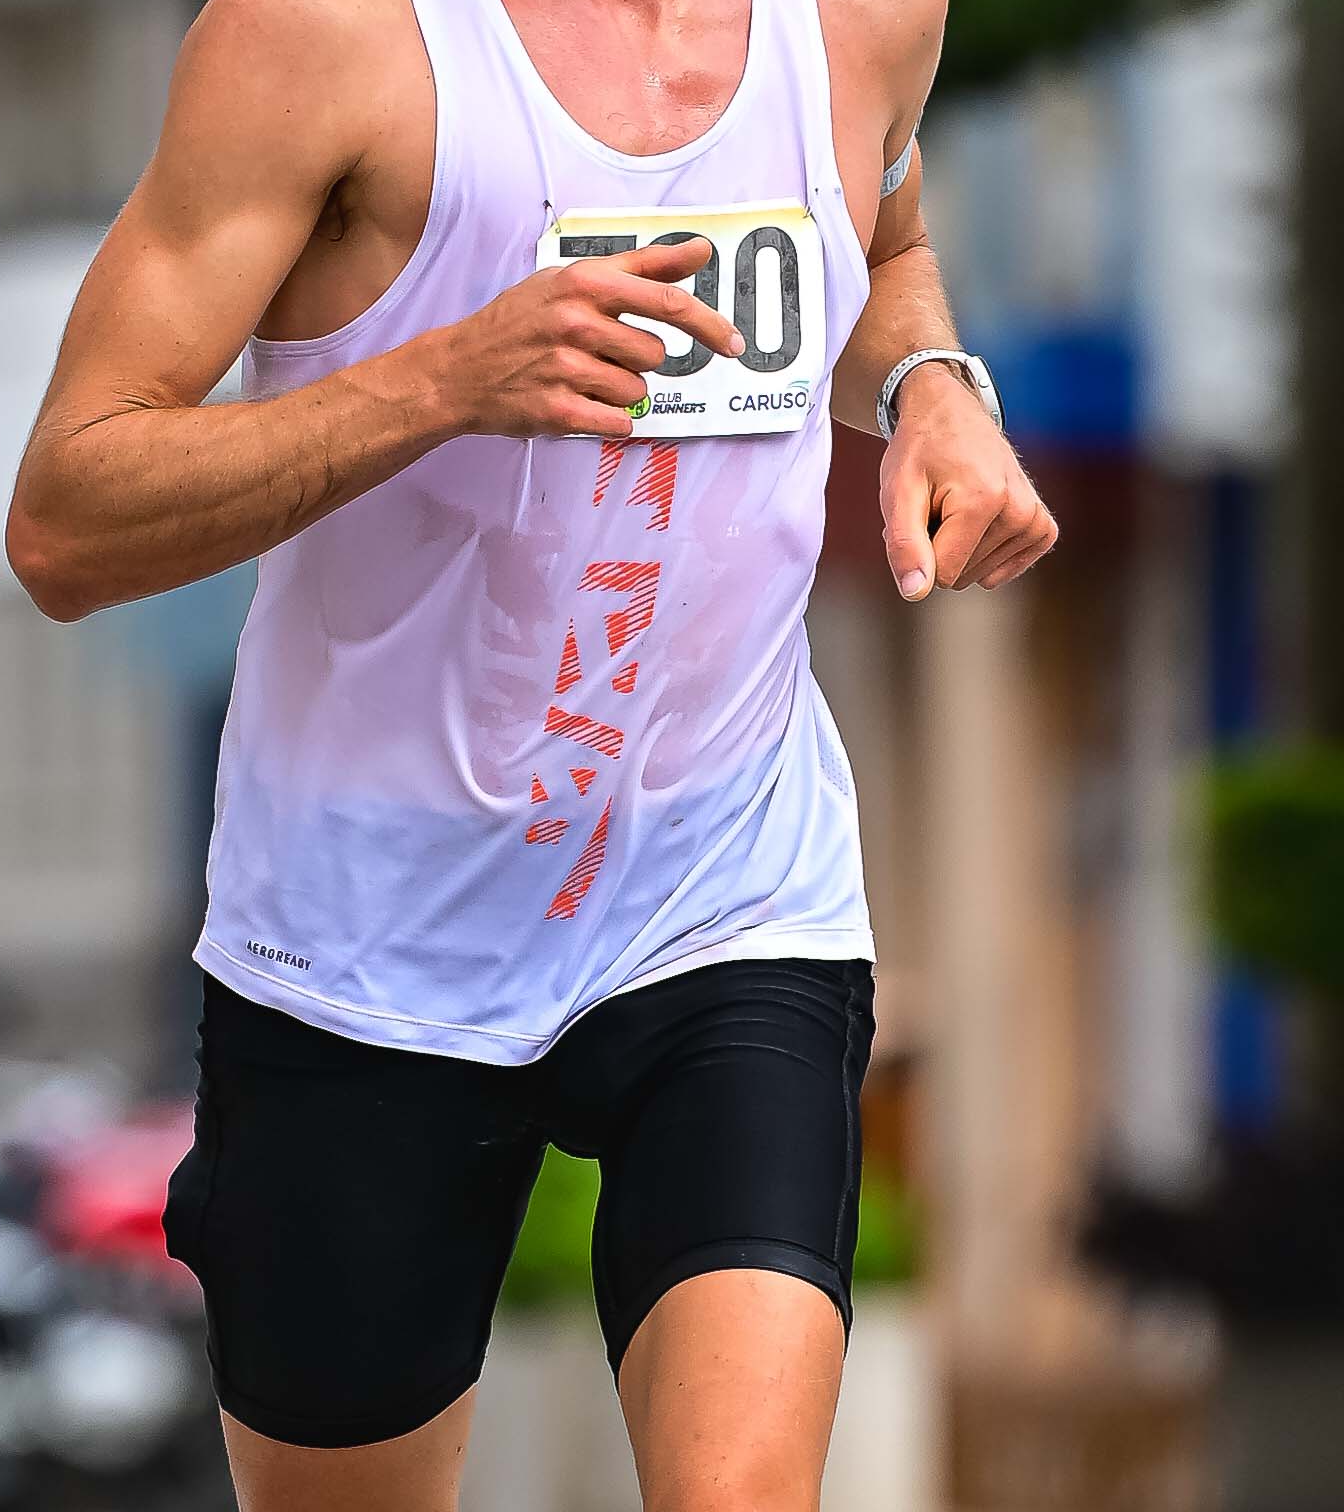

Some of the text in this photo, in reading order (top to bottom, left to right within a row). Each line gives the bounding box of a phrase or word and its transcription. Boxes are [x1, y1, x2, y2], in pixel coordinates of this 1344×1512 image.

[654, 392, 682, 403] CLUB
[729, 392, 807, 412] CARUSO
[247, 940, 312, 971] AEROREADY
